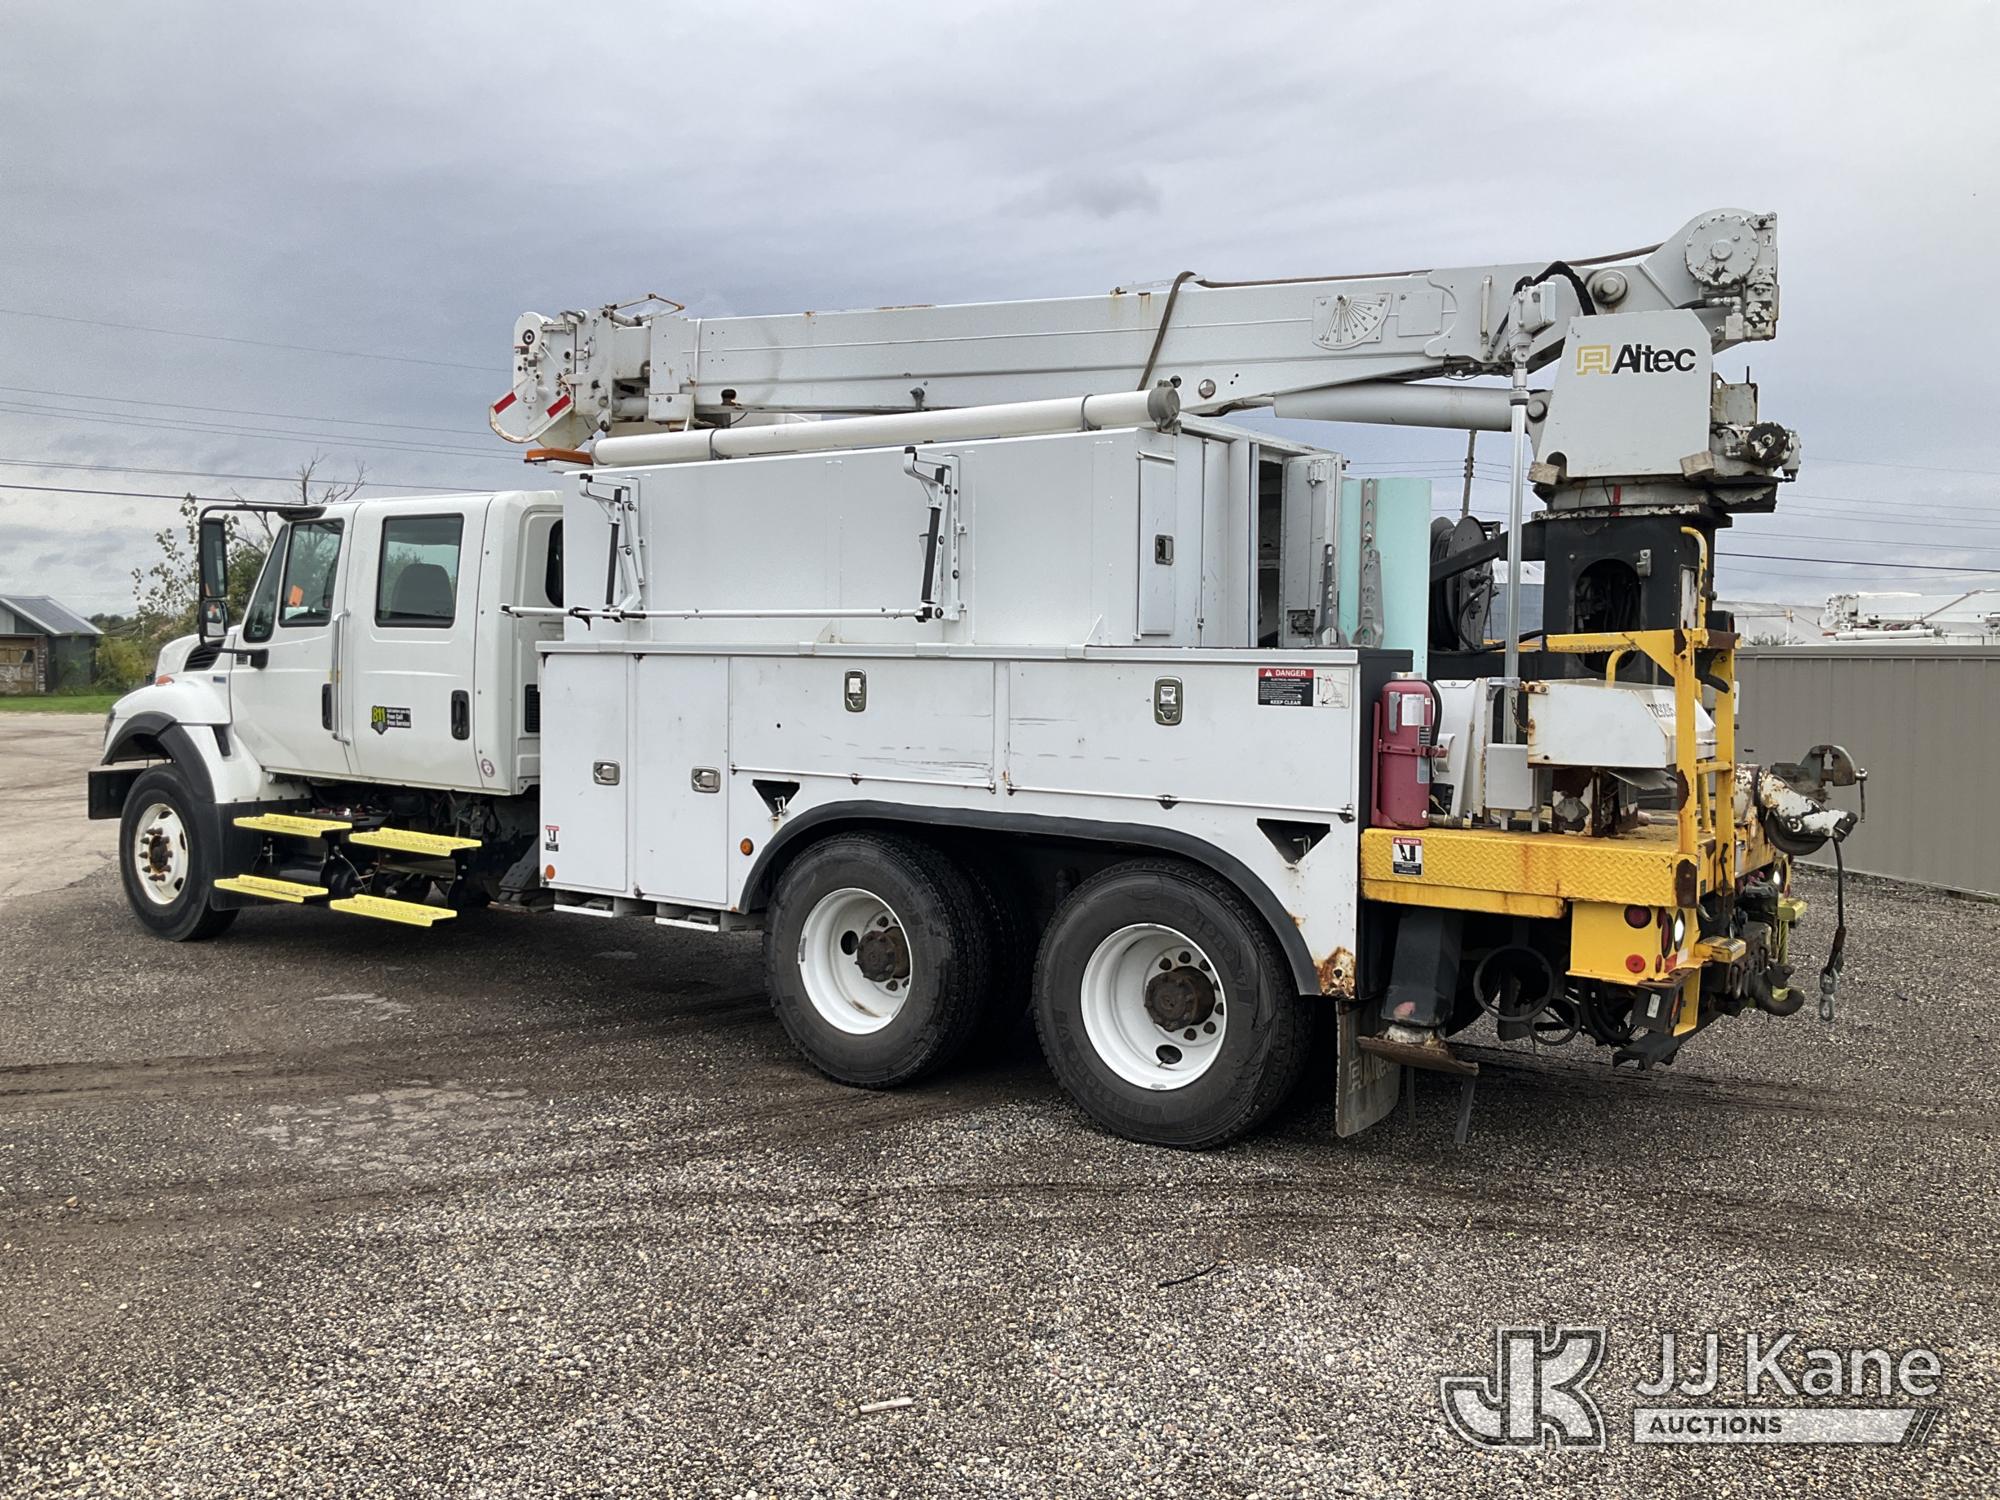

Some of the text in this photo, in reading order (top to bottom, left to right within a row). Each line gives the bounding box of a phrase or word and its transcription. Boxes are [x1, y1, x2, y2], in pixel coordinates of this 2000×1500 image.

[1611, 344, 1696, 374] Altec
[1275, 669, 1306, 677] DANGER
[372, 707, 386, 723] 811
